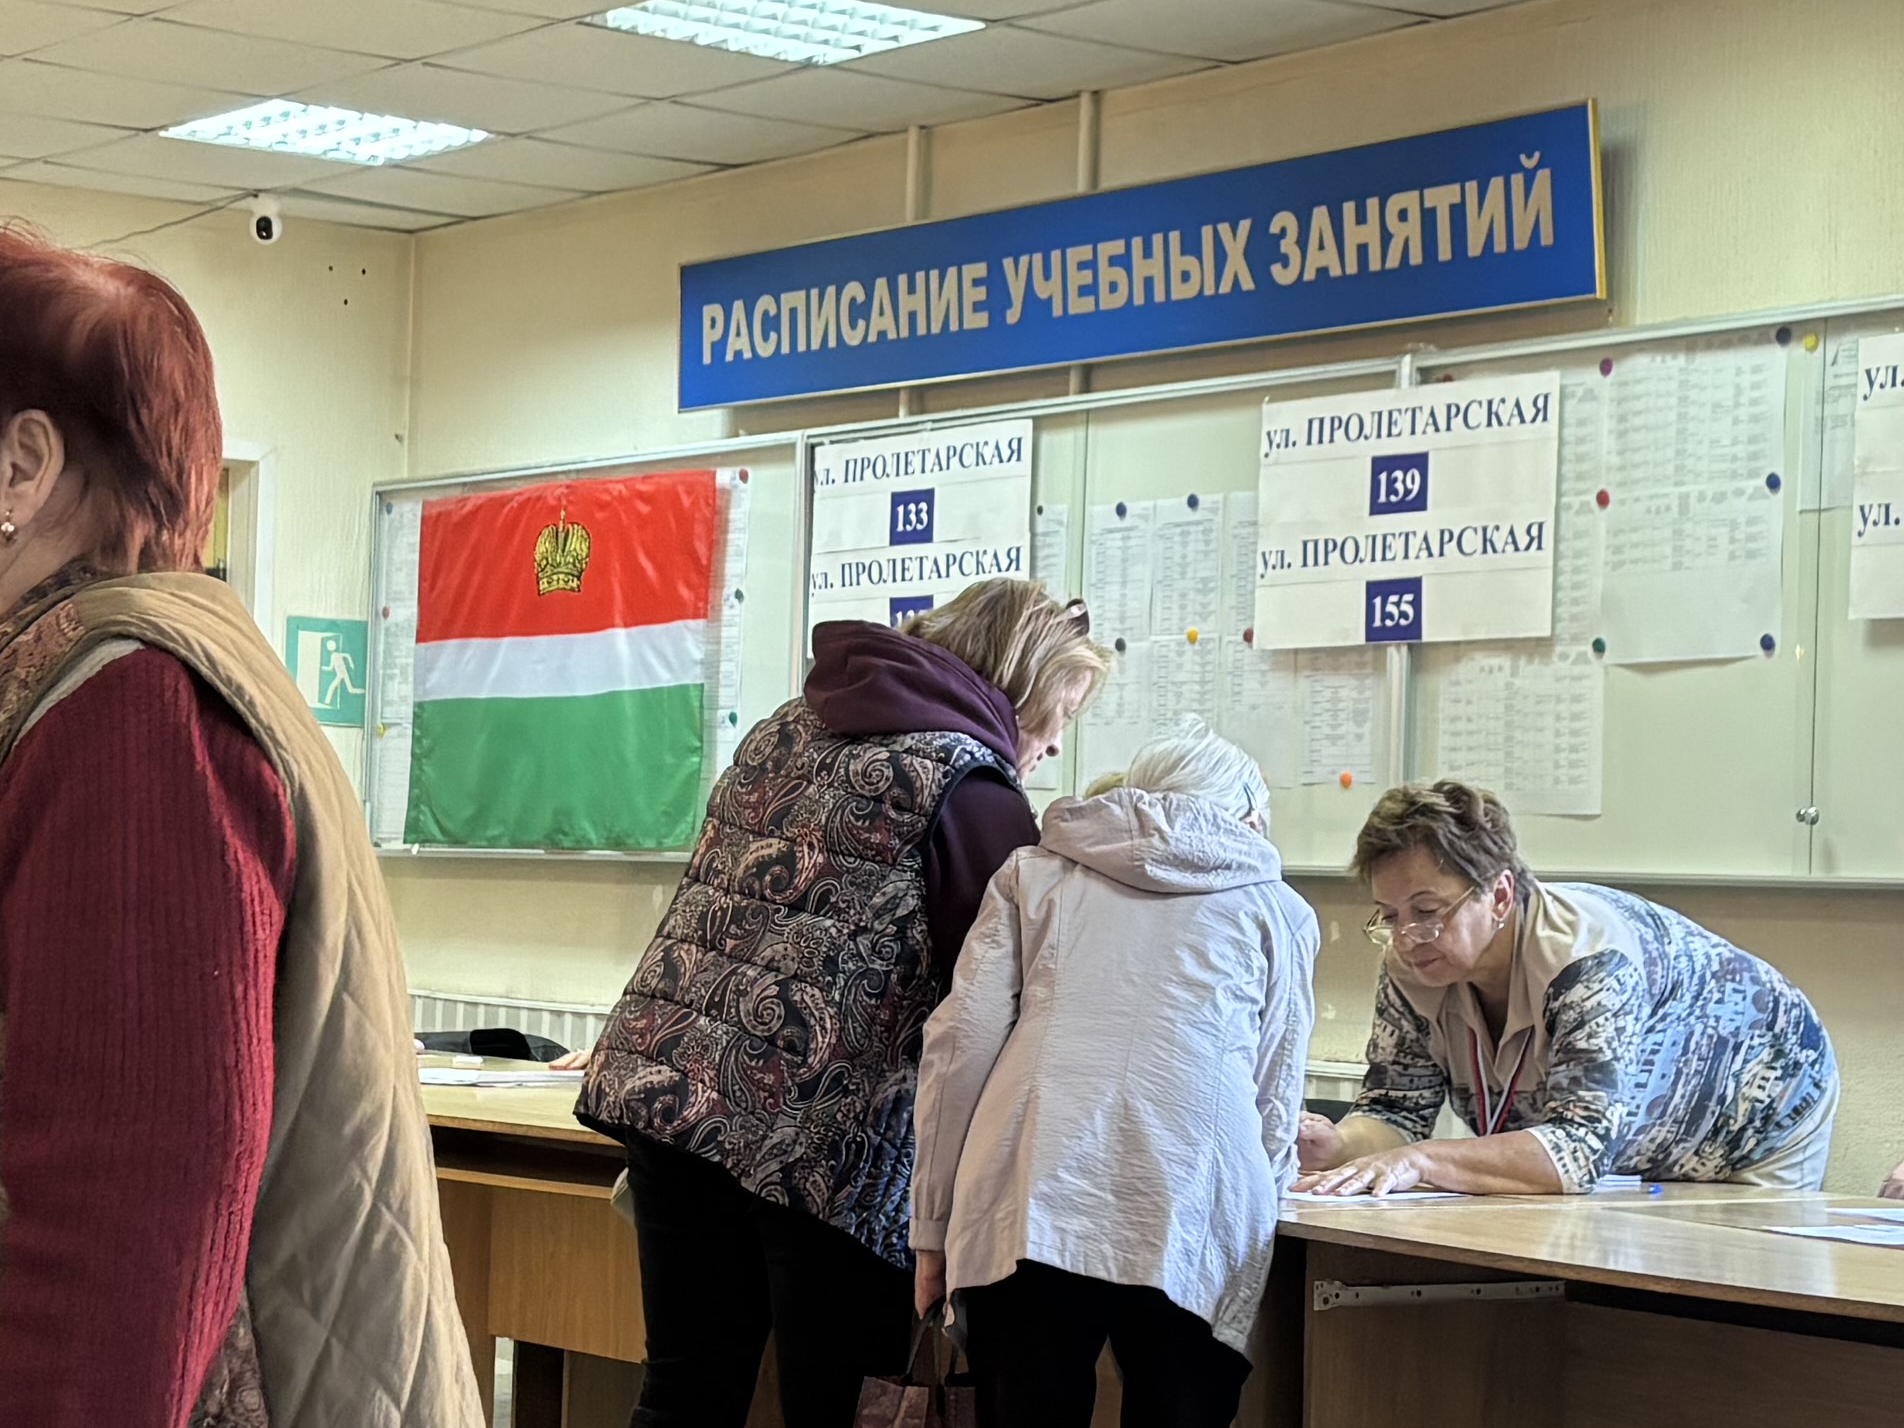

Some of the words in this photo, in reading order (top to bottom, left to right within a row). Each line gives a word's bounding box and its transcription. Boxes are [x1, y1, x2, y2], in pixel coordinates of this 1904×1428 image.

[701, 261, 989, 366] РАСПИСАНИЕ
[1002, 218, 1256, 325] УЧЕБНЫХ
[1267, 149, 1556, 286] ЗАНЯТИЙ
[1264, 425, 1297, 459] ул.
[1305, 392, 1552, 447] ПРОЛЕТАРСКАЯ
[843, 437, 1024, 483] ПРОЛЕТАРСКАЯ
[1376, 466, 1421, 504] 139
[895, 501, 929, 532] 133
[1856, 501, 1901, 537] ул.
[840, 546, 1024, 588] ПРОЛЕТАРСКАЯ
[1260, 545, 1292, 579] ул.
[1300, 520, 1548, 570] ПРОЛЕТАРСКАЯ
[1371, 592, 1415, 628] 155
